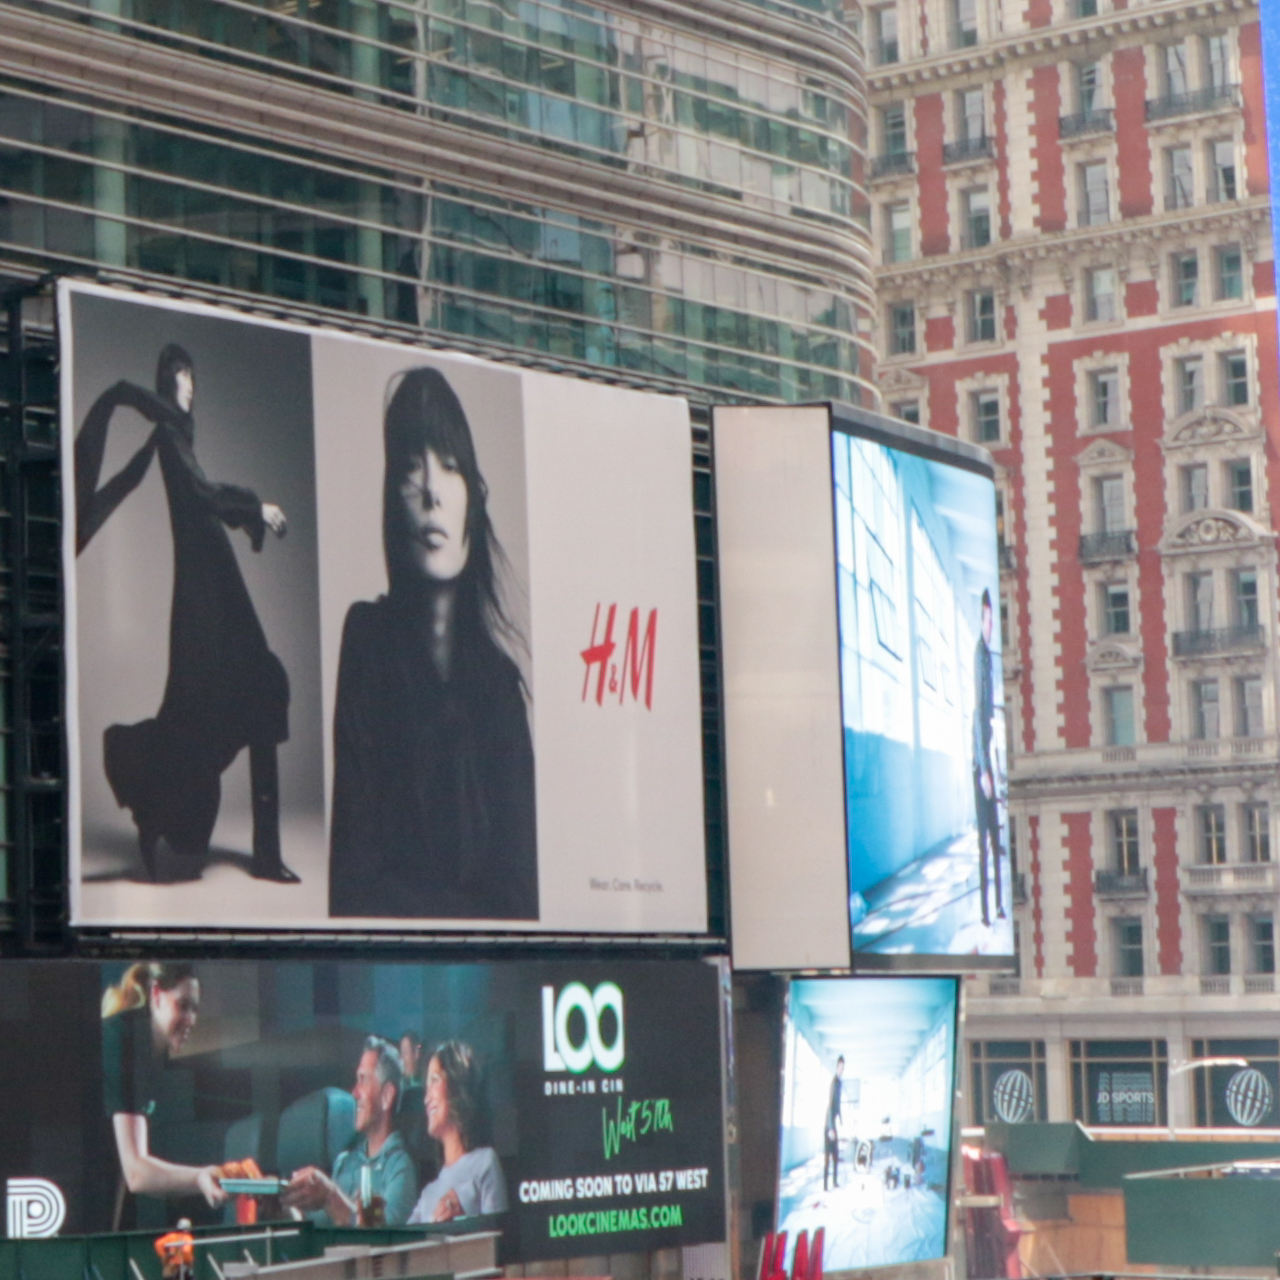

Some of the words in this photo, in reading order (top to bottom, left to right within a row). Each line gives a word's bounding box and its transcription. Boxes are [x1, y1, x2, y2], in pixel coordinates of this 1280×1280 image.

[580, 602, 658, 712] H&M
[544, 1080, 596, 1096] DINE-IN
[1097, 1092, 1110, 1104] JD
[1112, 1092, 1154, 1104] SPORTS
[519, 1178, 574, 1203] COMING
[575, 1175, 613, 1198] SOON
[614, 1174, 633, 1195] TO
[634, 1171, 657, 1193] VIA
[658, 1171, 674, 1191] 57
[675, 1168, 709, 1191] WEST
[548, 1204, 683, 1238] LOOKCINEMAS.COM
